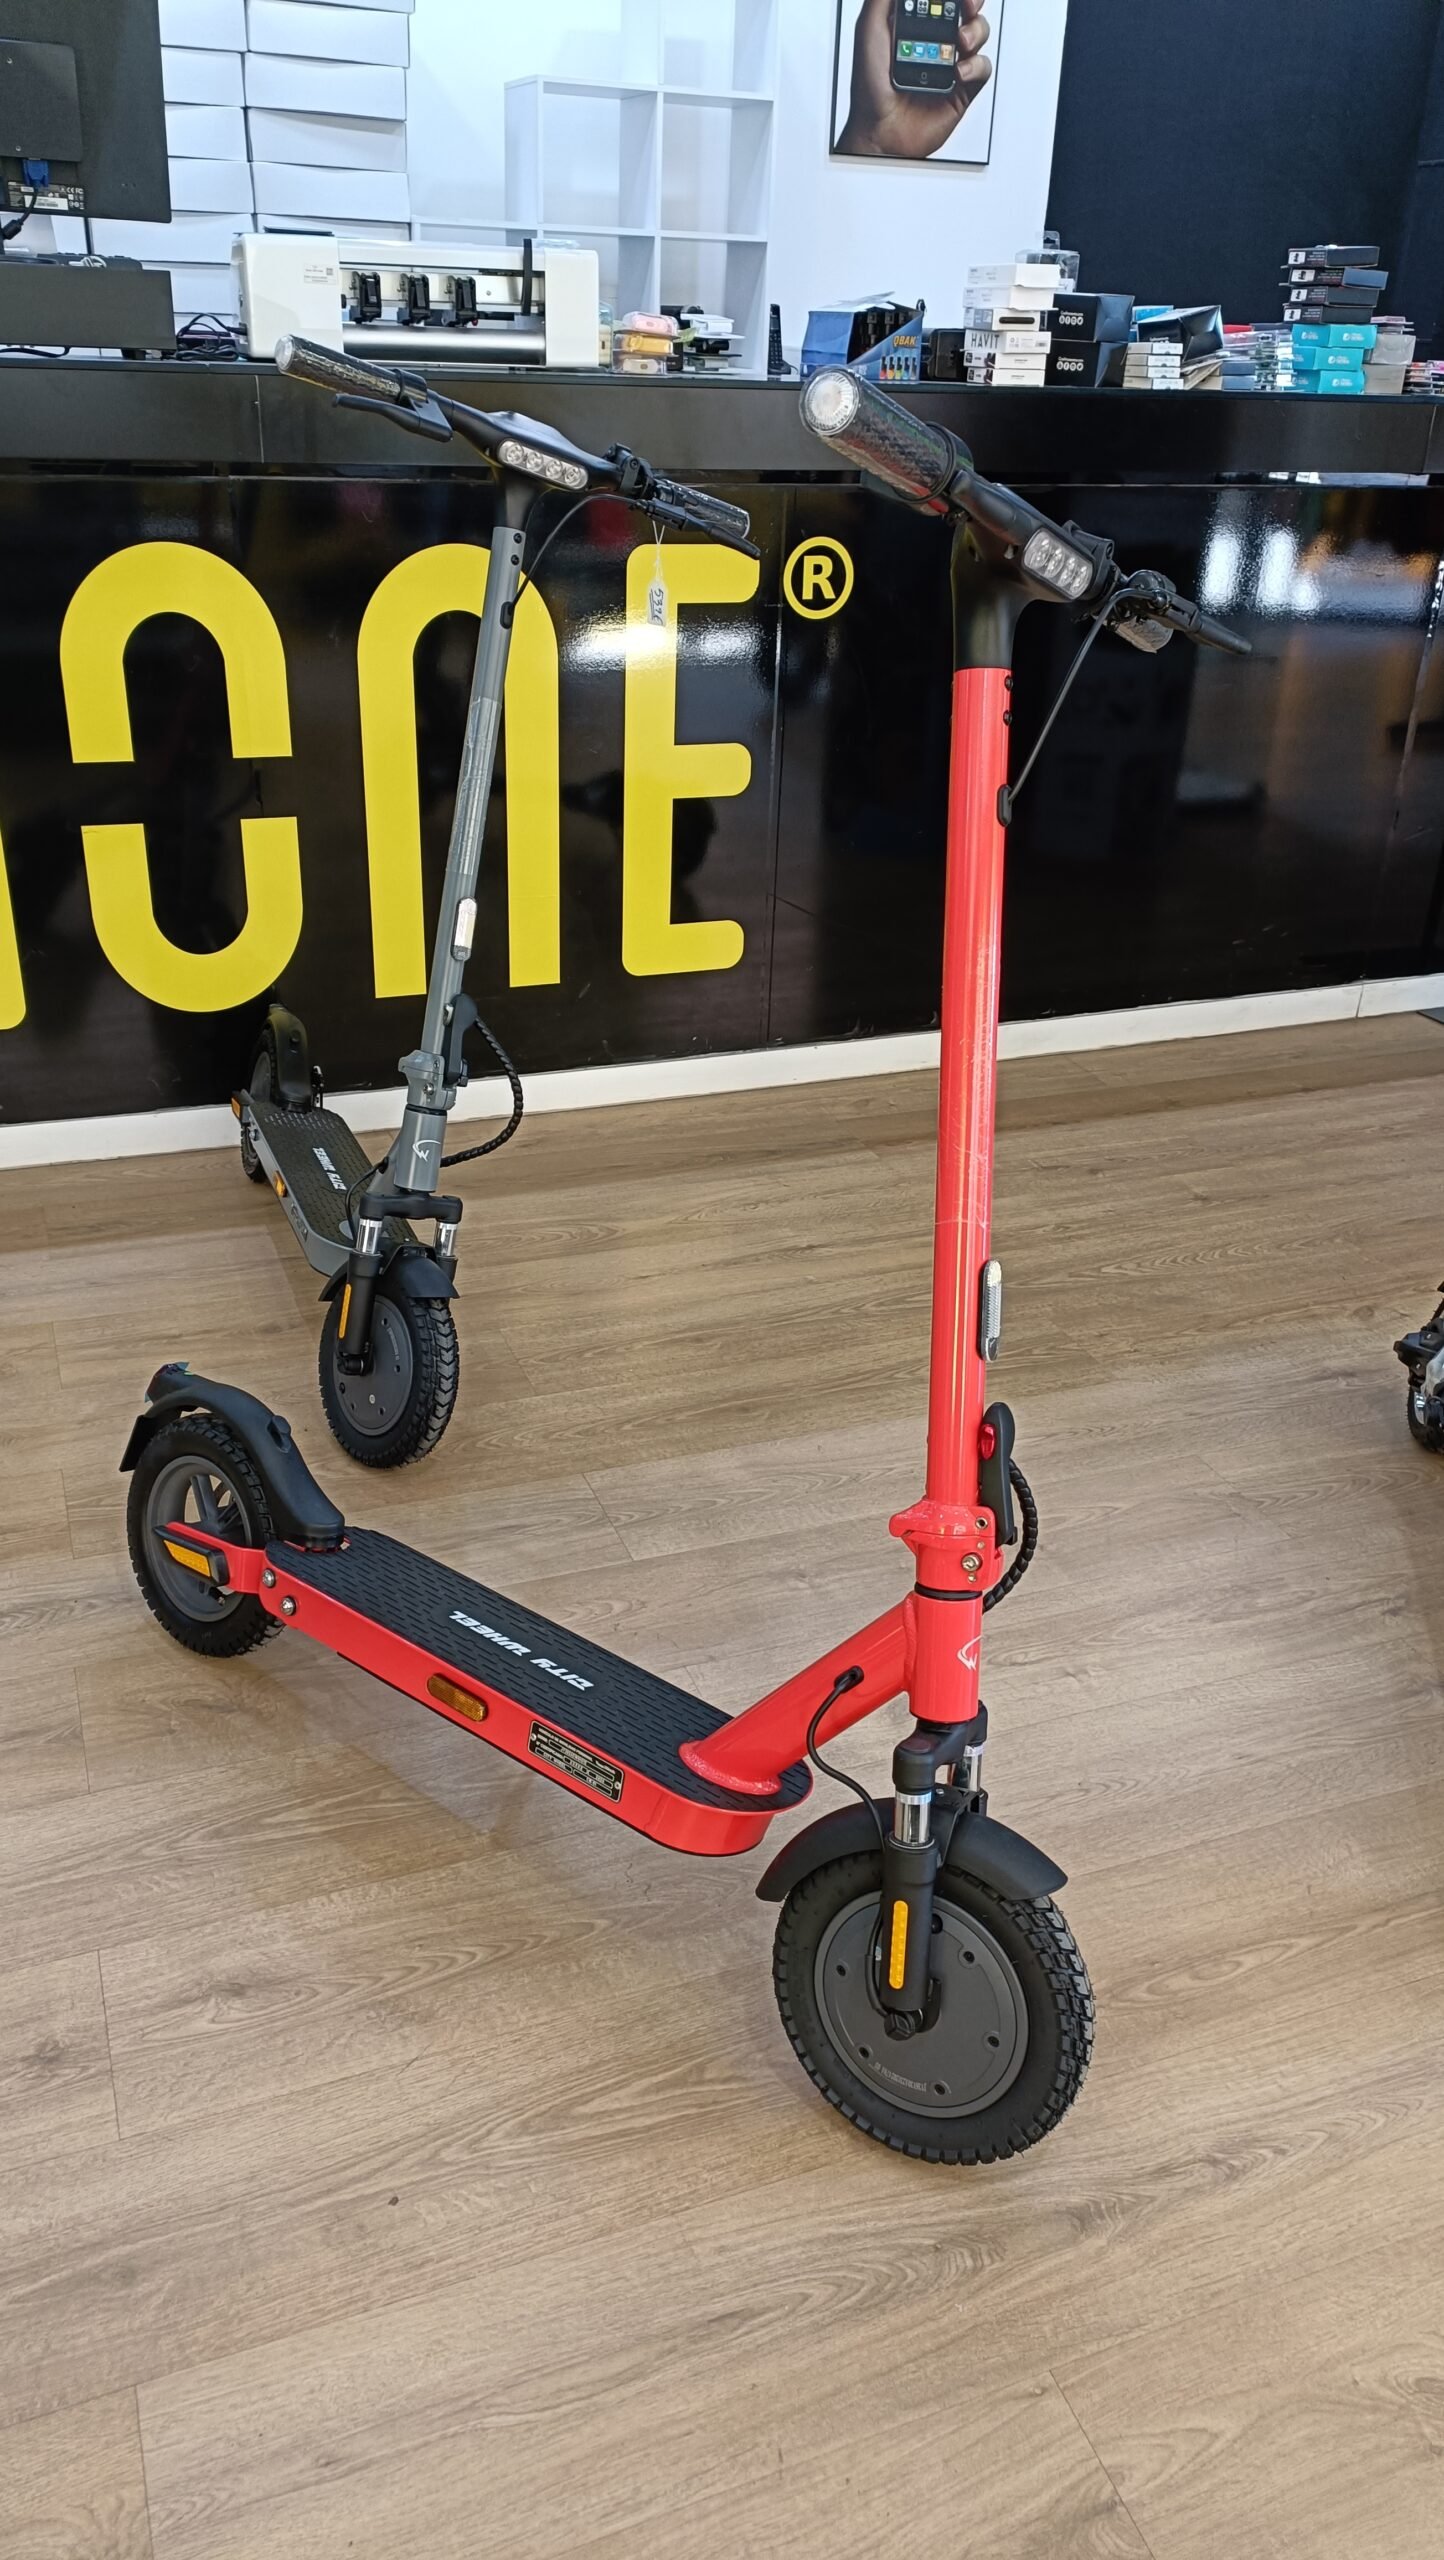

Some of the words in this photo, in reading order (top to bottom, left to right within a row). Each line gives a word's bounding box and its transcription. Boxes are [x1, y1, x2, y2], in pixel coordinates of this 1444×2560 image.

[893, 335, 916, 347] QBAK
[971, 332, 1000, 349] HAVIT
[449, 1610, 531, 1656] WHEEL
[530, 1658, 594, 1691] CITY
